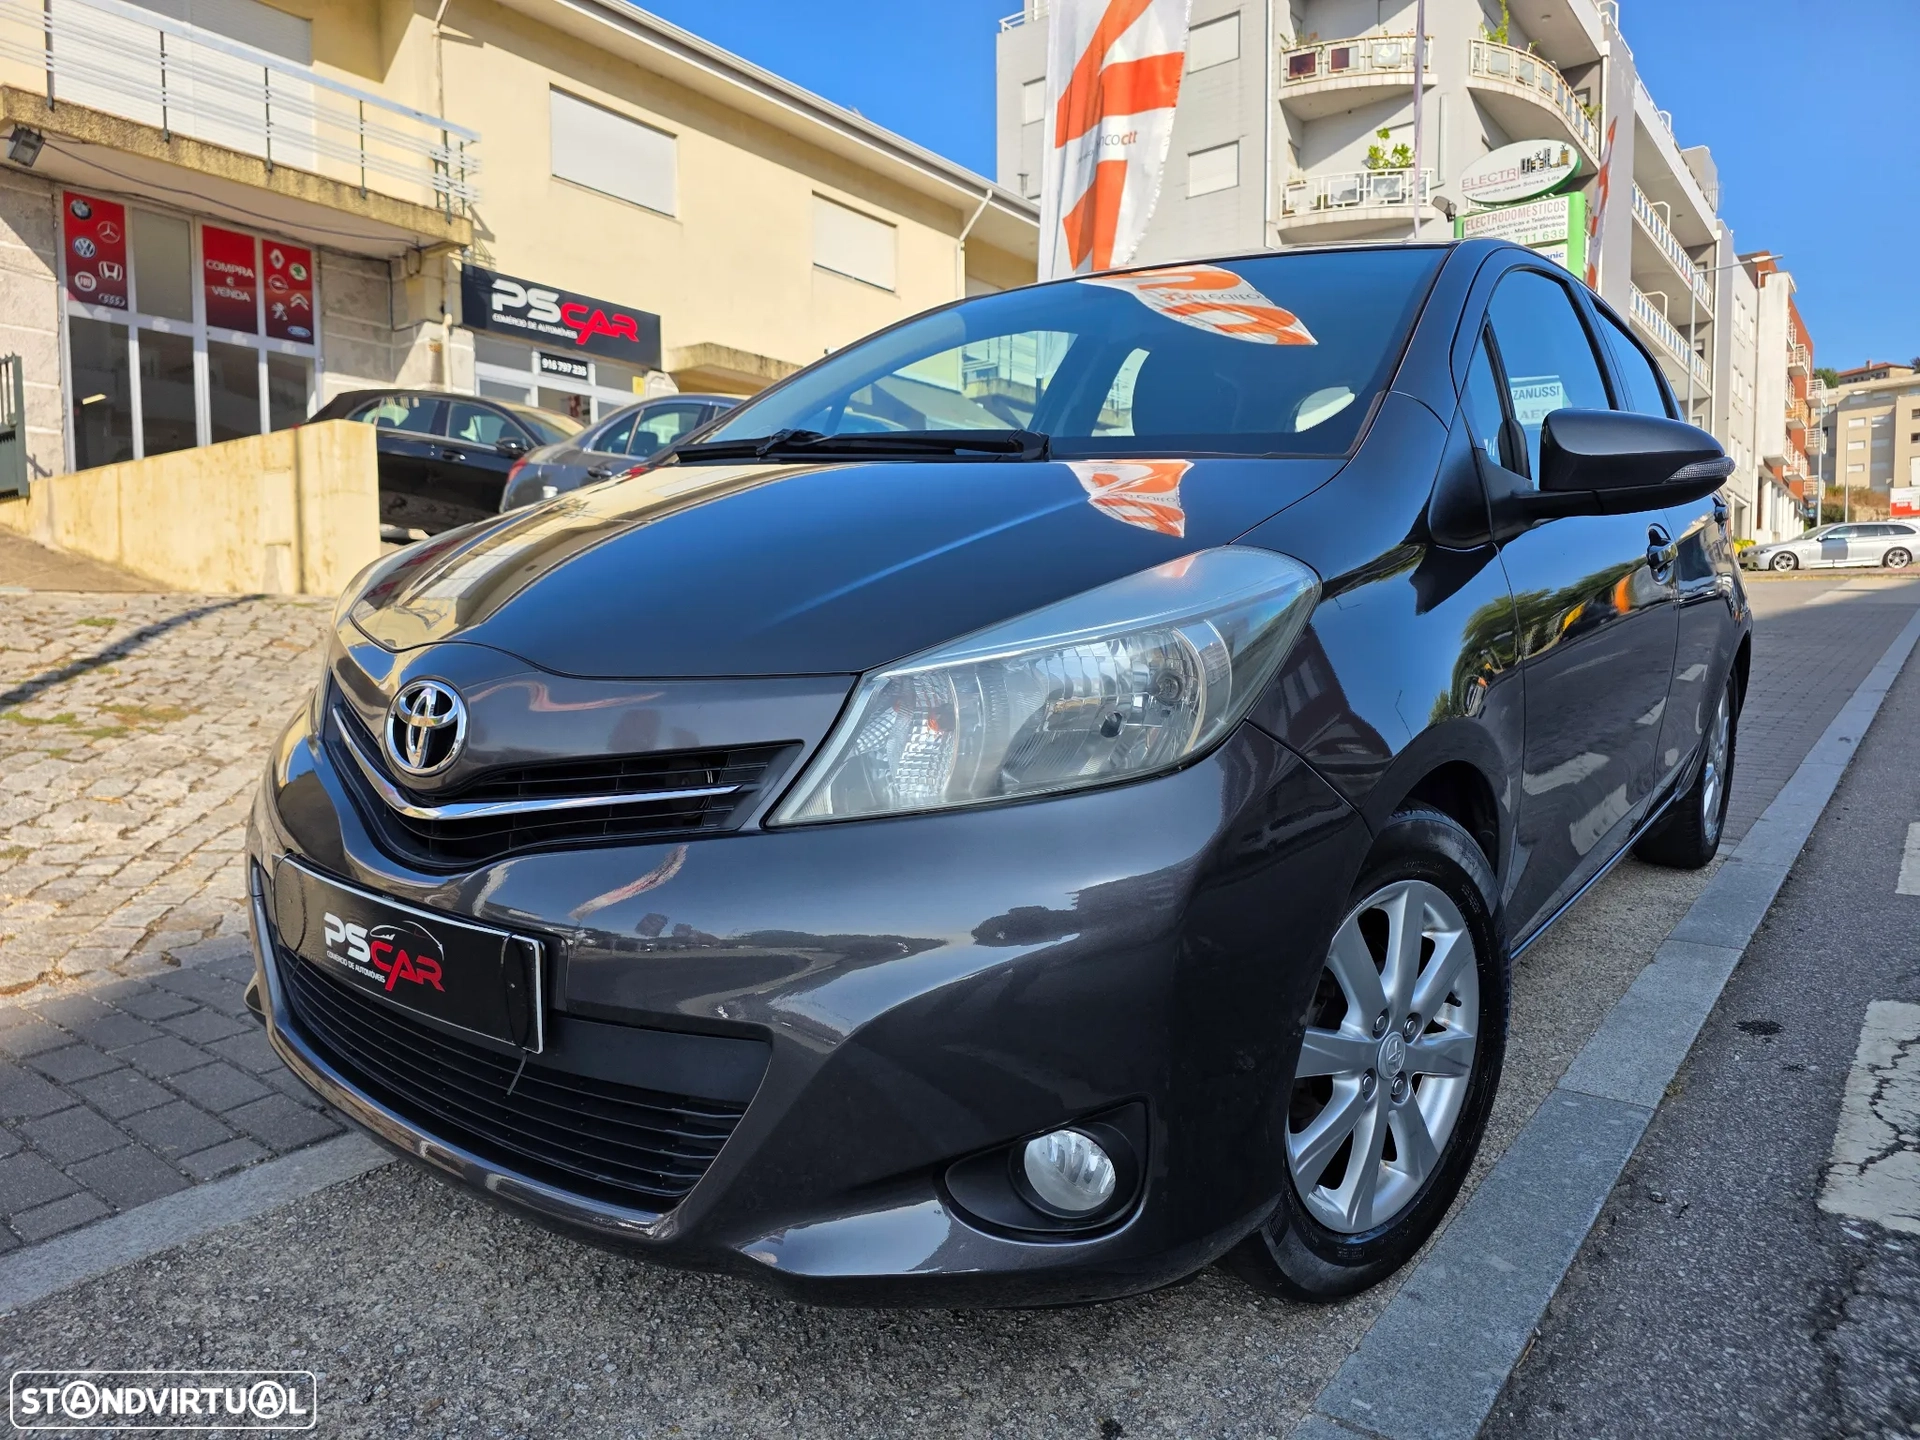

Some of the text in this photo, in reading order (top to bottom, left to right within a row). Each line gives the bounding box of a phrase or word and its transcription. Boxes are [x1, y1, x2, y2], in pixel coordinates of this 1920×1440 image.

[1542, 228, 1566, 241] 639
[206, 259, 255, 279] COMPRA
[211, 285, 251, 303] VENDA
[1512, 385, 1561, 401] ZANUSSI
